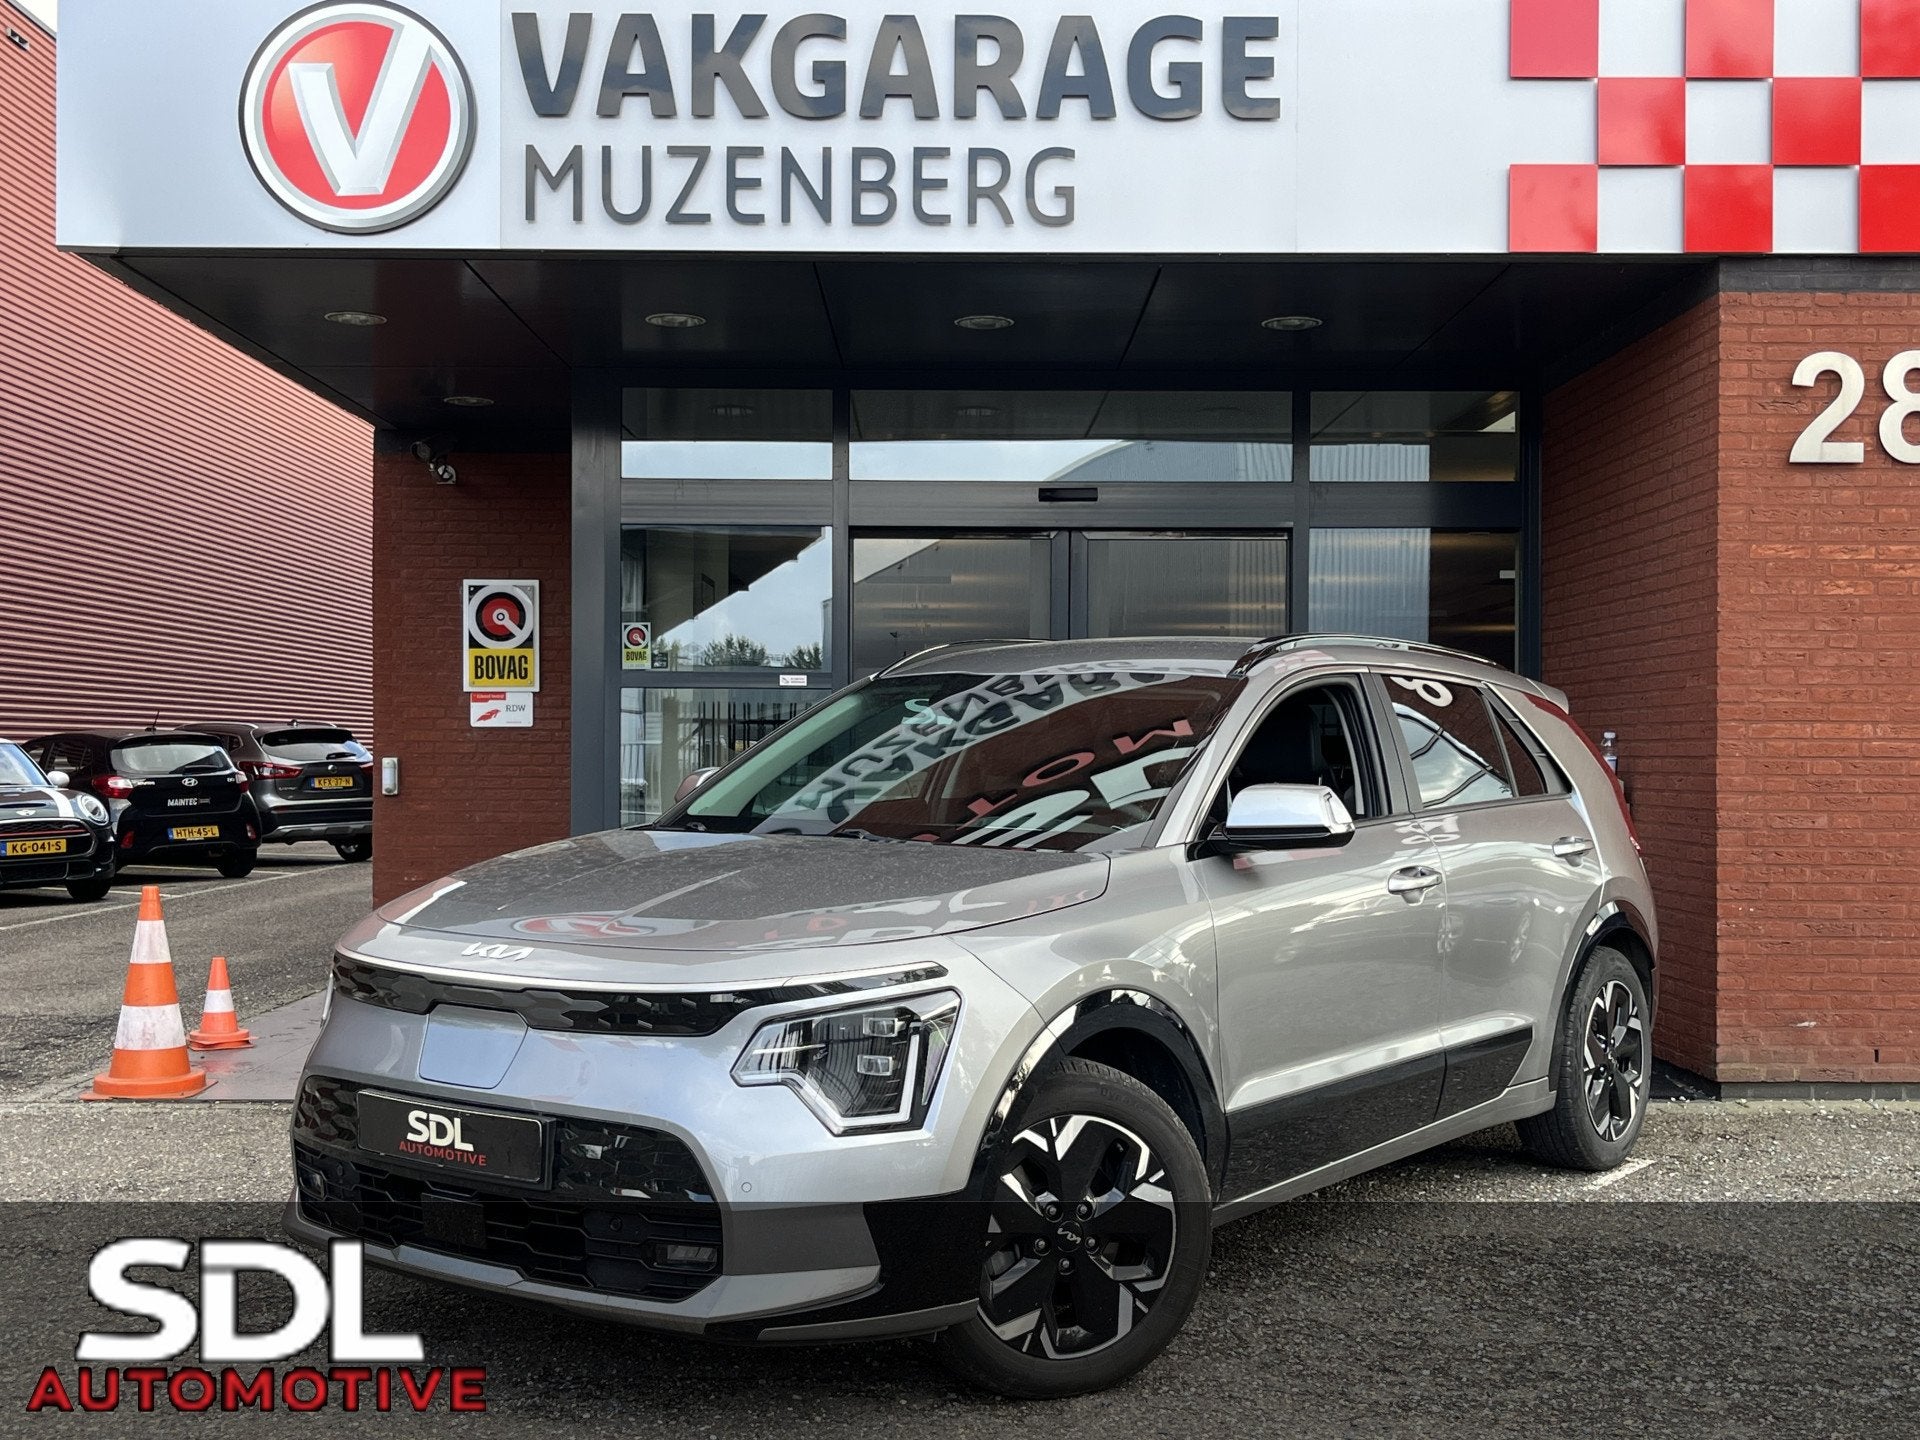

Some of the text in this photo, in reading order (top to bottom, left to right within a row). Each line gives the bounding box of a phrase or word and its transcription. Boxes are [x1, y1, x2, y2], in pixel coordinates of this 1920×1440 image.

[512, 11, 1282, 121] VAKGARAGE
[524, 144, 1077, 228] MUZENBERG
[474, 654, 528, 680] BOVAG
[505, 704, 527, 713] RDW
[167, 797, 198, 807] MAINTEC
[175, 826, 217, 838] HTH-45-L
[11, 840, 62, 854] KG-041-S
[406, 1109, 475, 1152] SDL
[398, 1140, 488, 1167] AUTOMOTIVE
